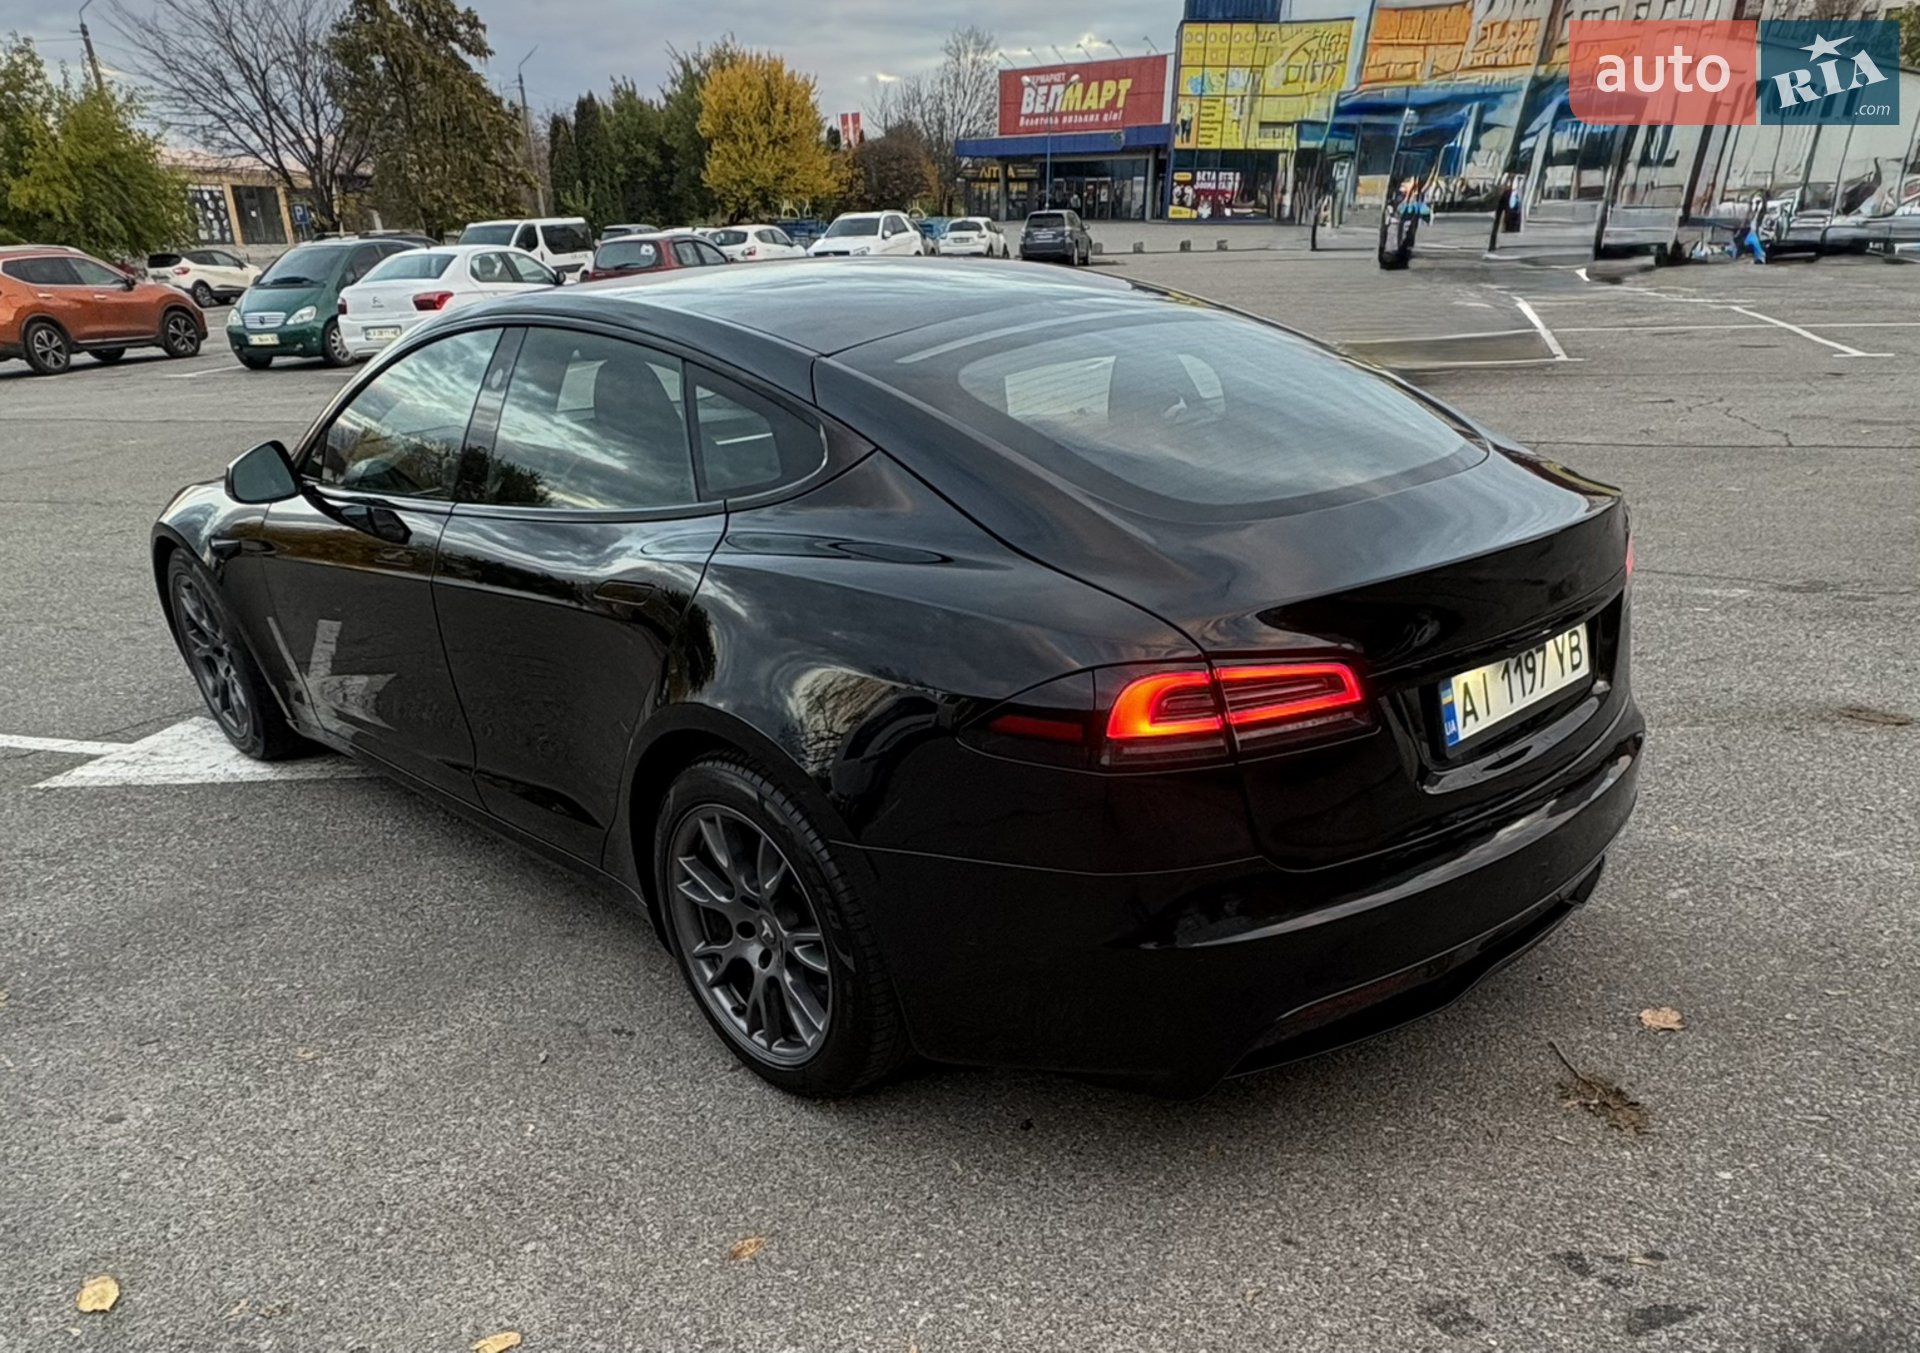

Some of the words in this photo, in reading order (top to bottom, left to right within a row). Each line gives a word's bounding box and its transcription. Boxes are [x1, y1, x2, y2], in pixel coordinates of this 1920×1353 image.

[1020, 78, 1133, 115] ВЕЛМАРТ
[1462, 672, 1491, 729] AI
[1501, 647, 1547, 704] 1197
[1554, 630, 1582, 677] YB
[1444, 720, 1457, 736] UA
